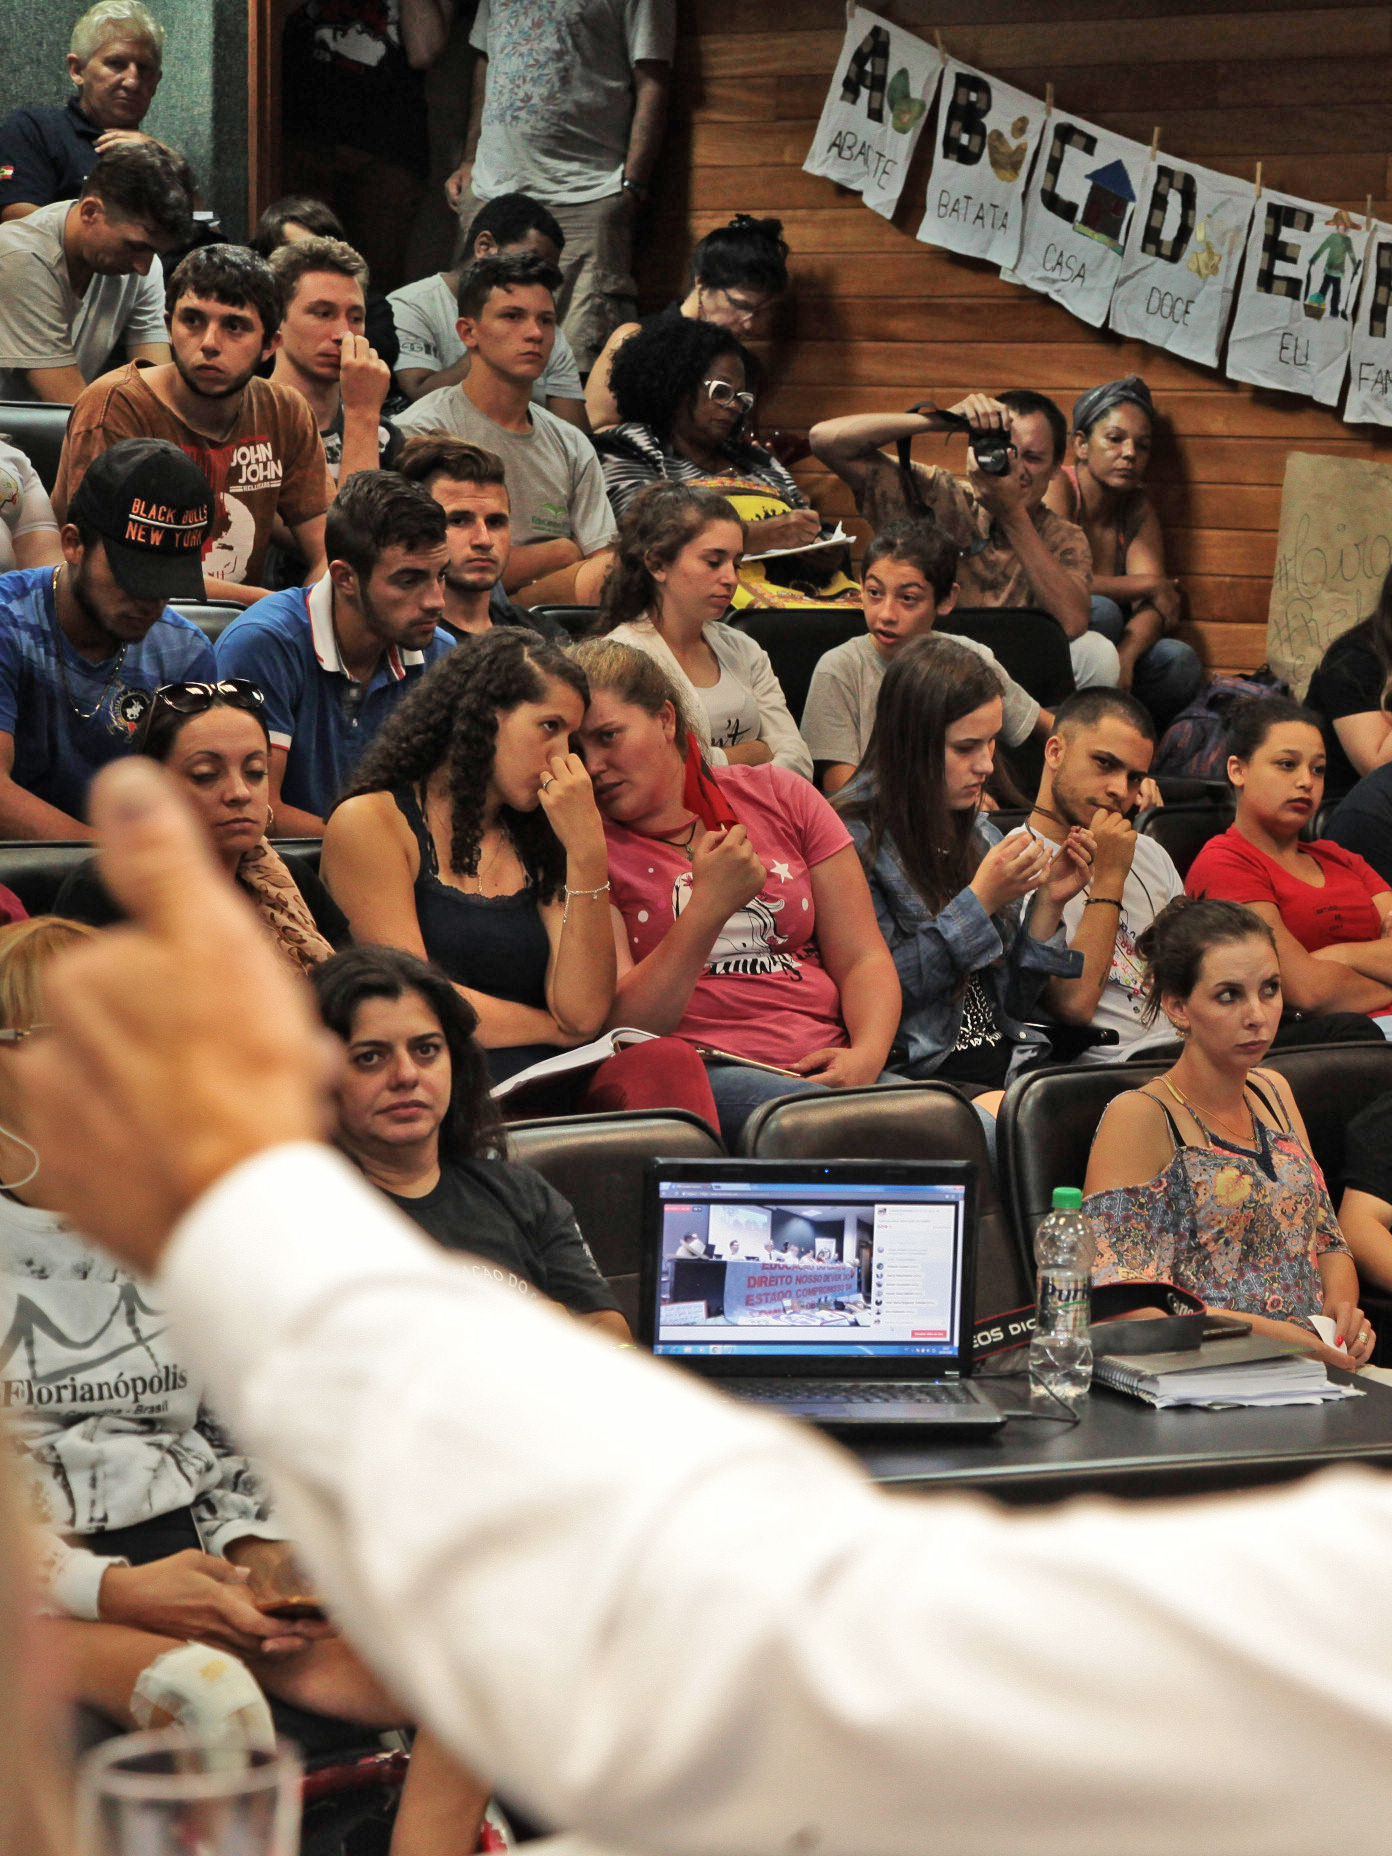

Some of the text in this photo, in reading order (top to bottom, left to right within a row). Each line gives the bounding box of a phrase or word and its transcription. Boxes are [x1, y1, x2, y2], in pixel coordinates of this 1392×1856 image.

[840, 24, 890, 124] A
[942, 71, 992, 166] B
[1040, 122, 1098, 224] C
[936, 189, 1009, 235] BATATA
[1140, 164, 1198, 264] D
[1042, 243, 1087, 286] CASA
[1256, 202, 1314, 301] E
[1146, 286, 1196, 327] DOCE
[1279, 331, 1310, 367] EU
[230, 442, 273, 467] JOHN
[238, 459, 283, 484] JOHN
[131, 498, 176, 523] BLACK
[125, 520, 166, 546] NEW
[508, 1273, 528, 1295] DO
[745, 1290, 792, 1306] ESTADO
[747, 1275, 793, 1288] DIREITO
[795, 1274, 822, 1285] NOSSO
[1, 1364, 188, 1408] Florianópolis
[133, 1400, 168, 1415] Brasil
